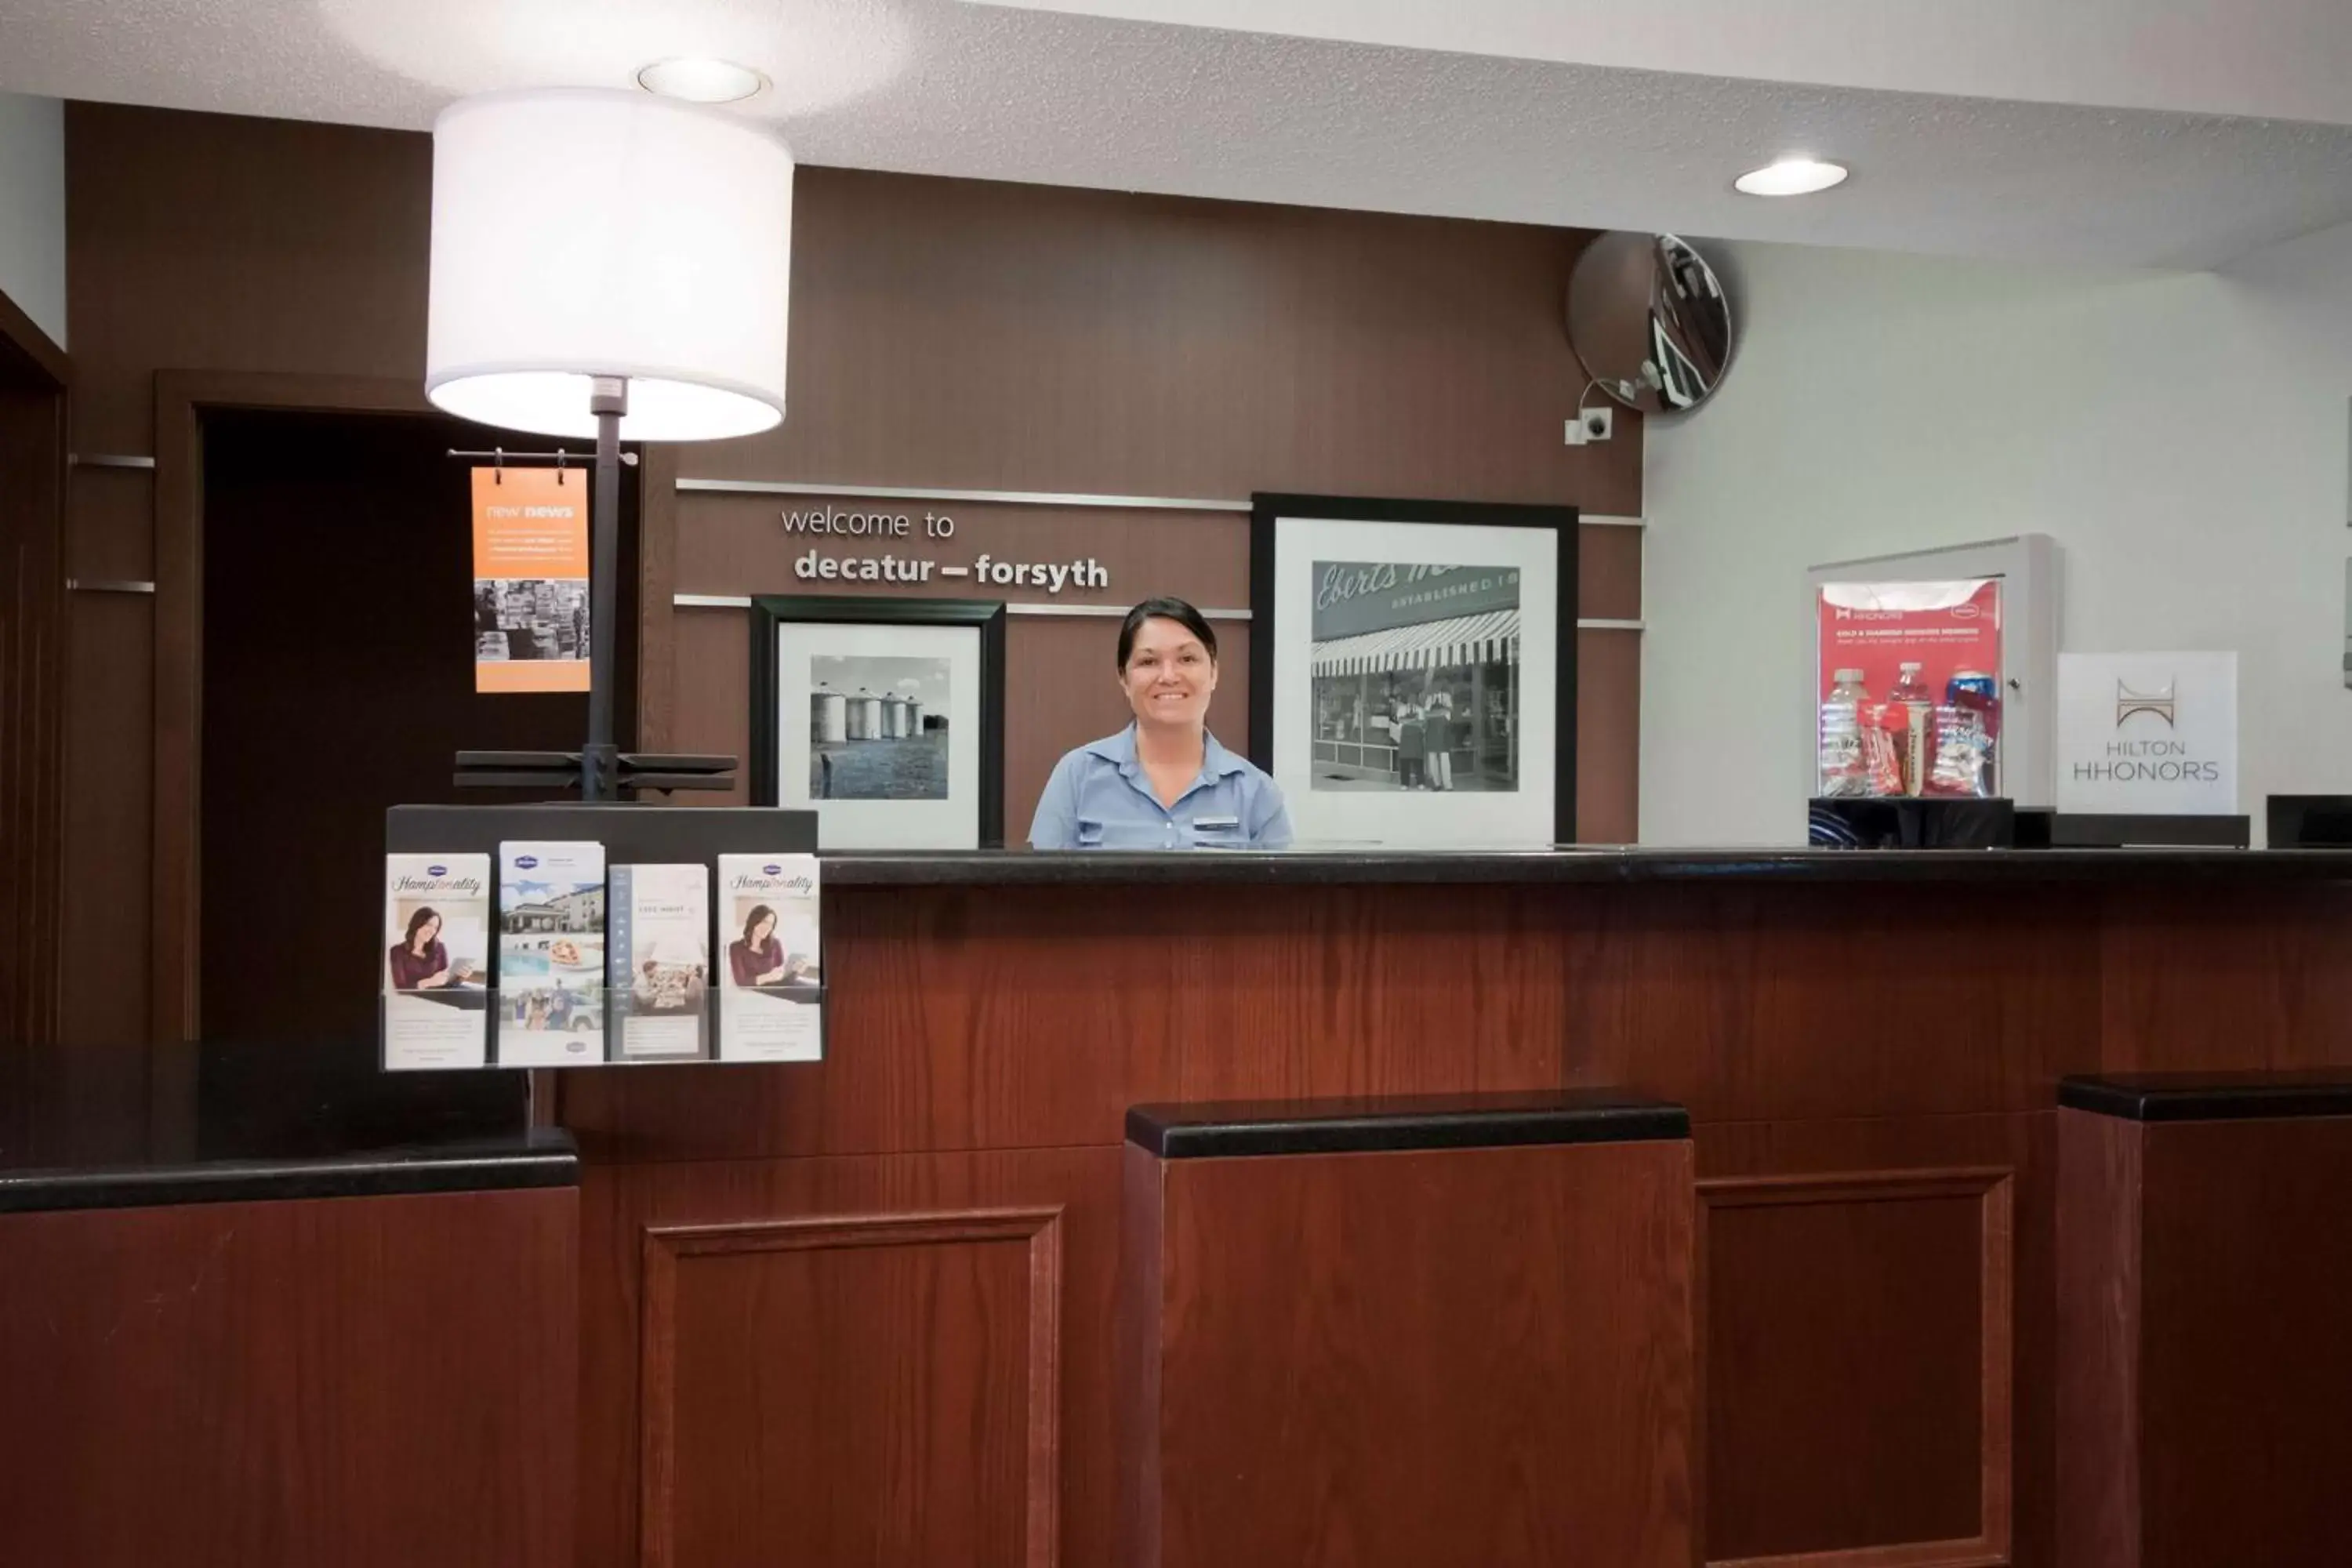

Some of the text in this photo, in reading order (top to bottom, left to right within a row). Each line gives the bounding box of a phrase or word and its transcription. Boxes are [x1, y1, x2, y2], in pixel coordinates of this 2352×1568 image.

[524, 506, 574, 518] news
[782, 505, 954, 538] welcome to
[1391, 578, 1493, 609] ESTABLISHED
[2107, 740, 2186, 757] HILTON
[2074, 760, 2220, 782] HHONORS
